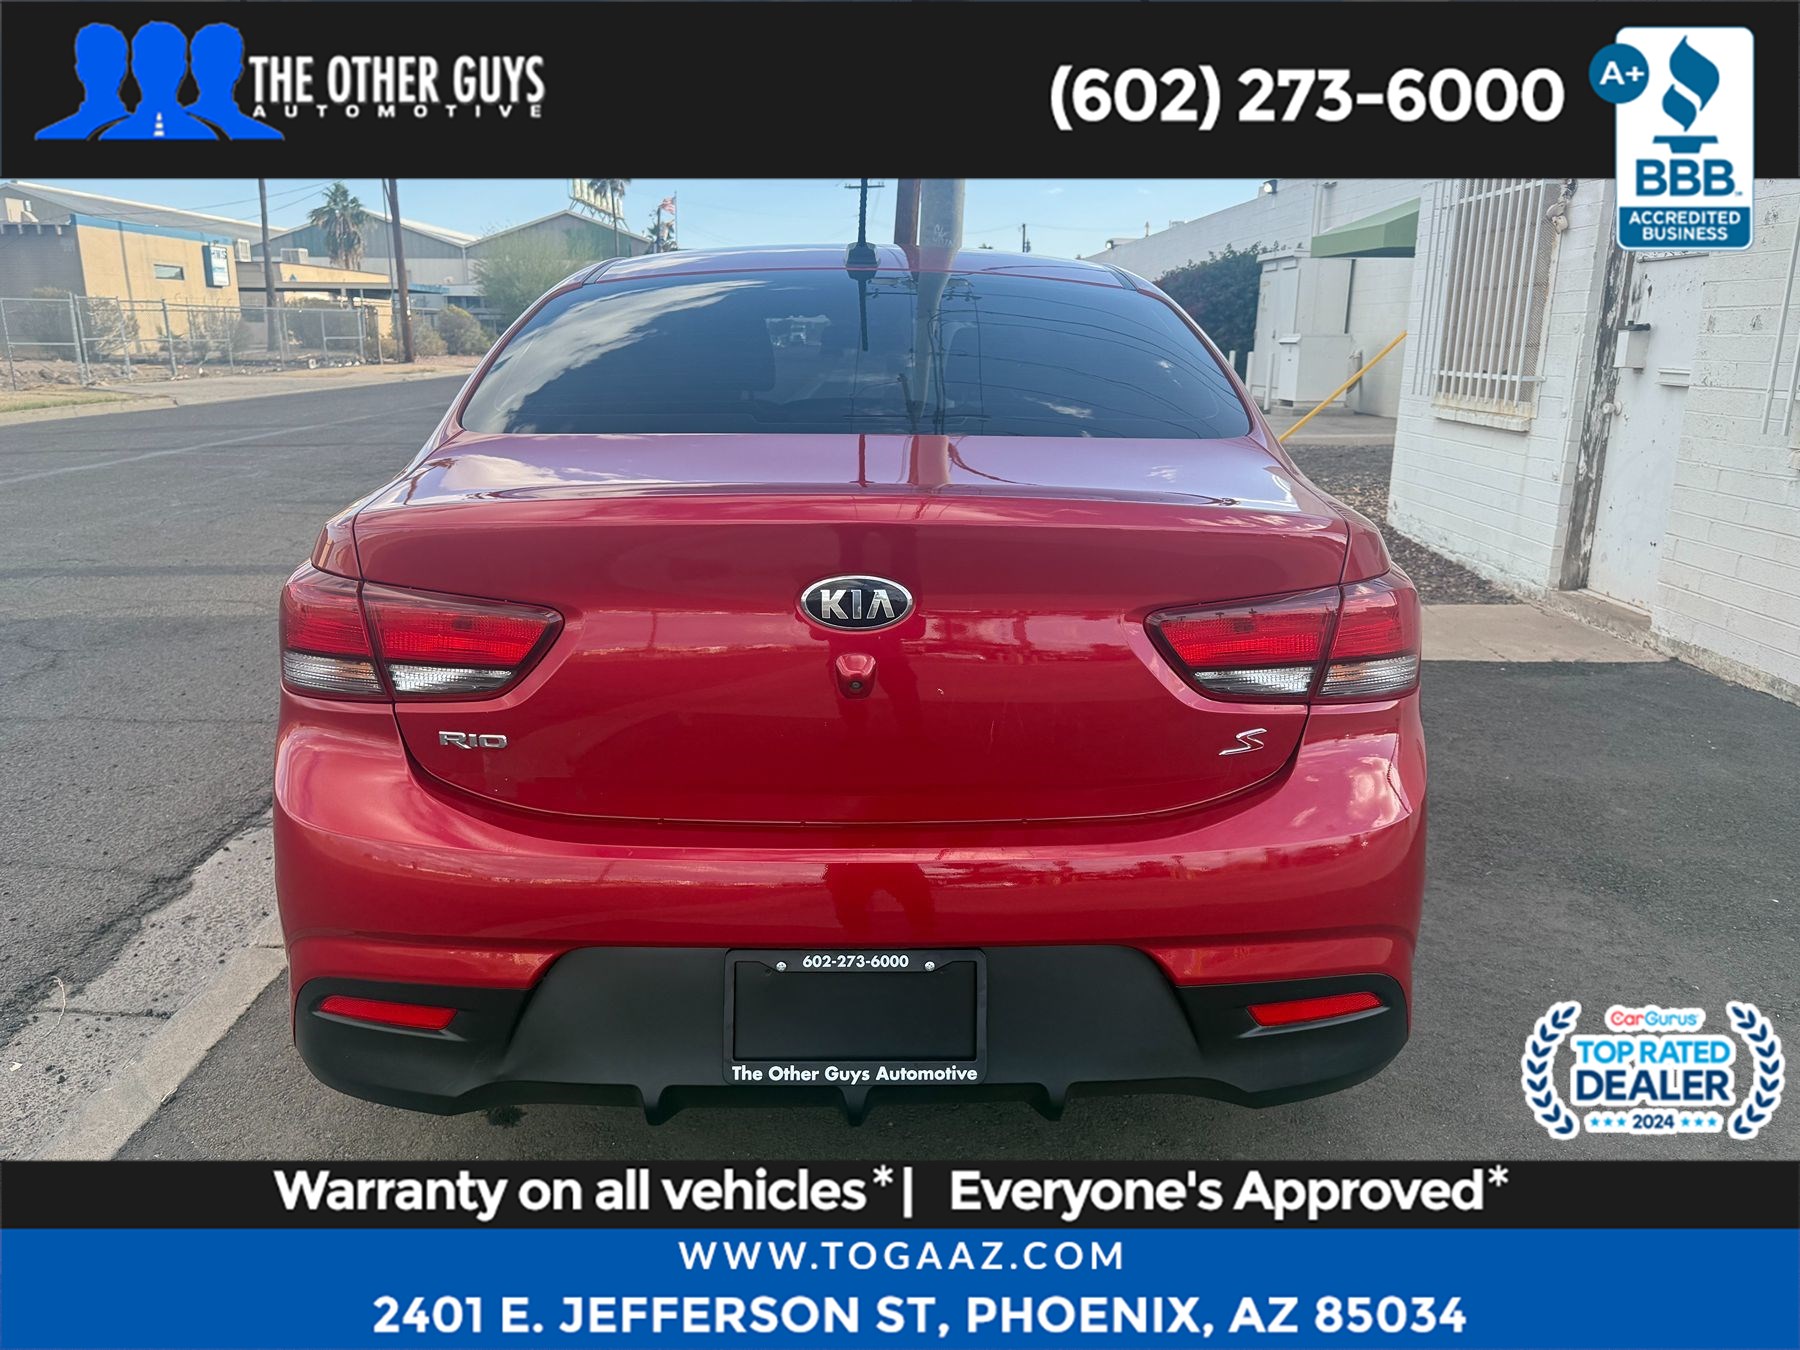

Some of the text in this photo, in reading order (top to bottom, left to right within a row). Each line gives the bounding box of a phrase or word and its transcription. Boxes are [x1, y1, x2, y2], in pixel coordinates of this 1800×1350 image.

[820, 589, 896, 620] KIA
[438, 730, 509, 750] RIO
[1218, 727, 1268, 757] S
[802, 954, 909, 969] 602-273-6000
[732, 1065, 978, 1086] The Other Guys Automotive
